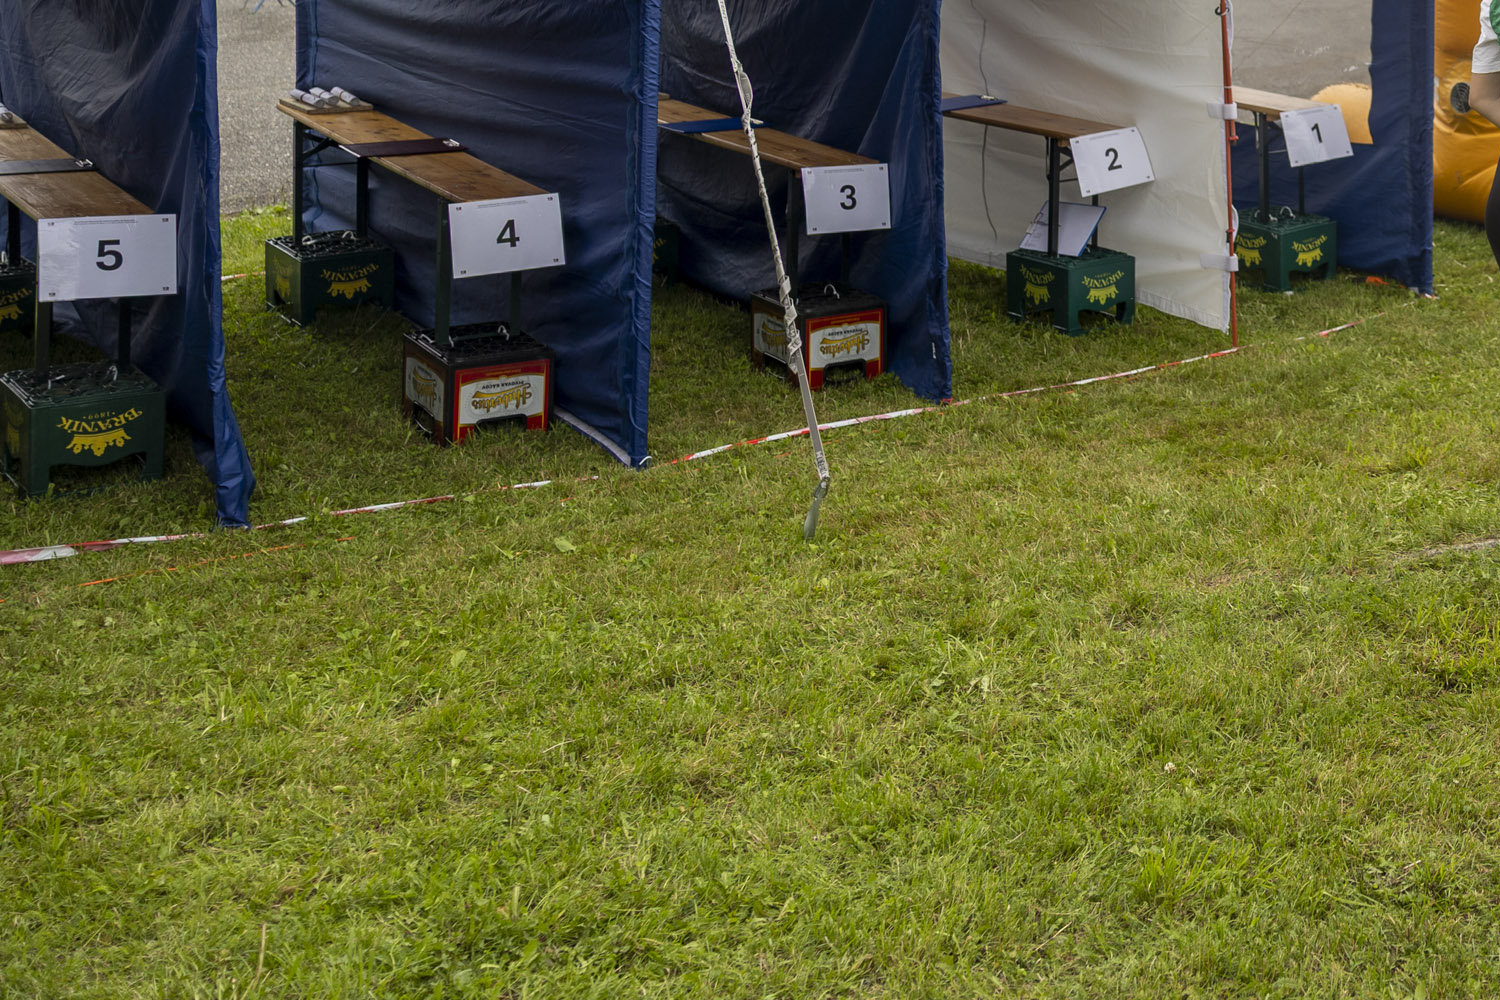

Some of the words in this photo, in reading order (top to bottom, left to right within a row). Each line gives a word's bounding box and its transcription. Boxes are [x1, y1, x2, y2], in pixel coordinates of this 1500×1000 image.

[1311, 122, 1323, 144] 1
[1105, 147, 1122, 171] 2
[840, 184, 857, 210] 3
[496, 219, 520, 248] 4
[96, 239, 123, 271] 5
[472, 387, 532, 412] Hubertus
